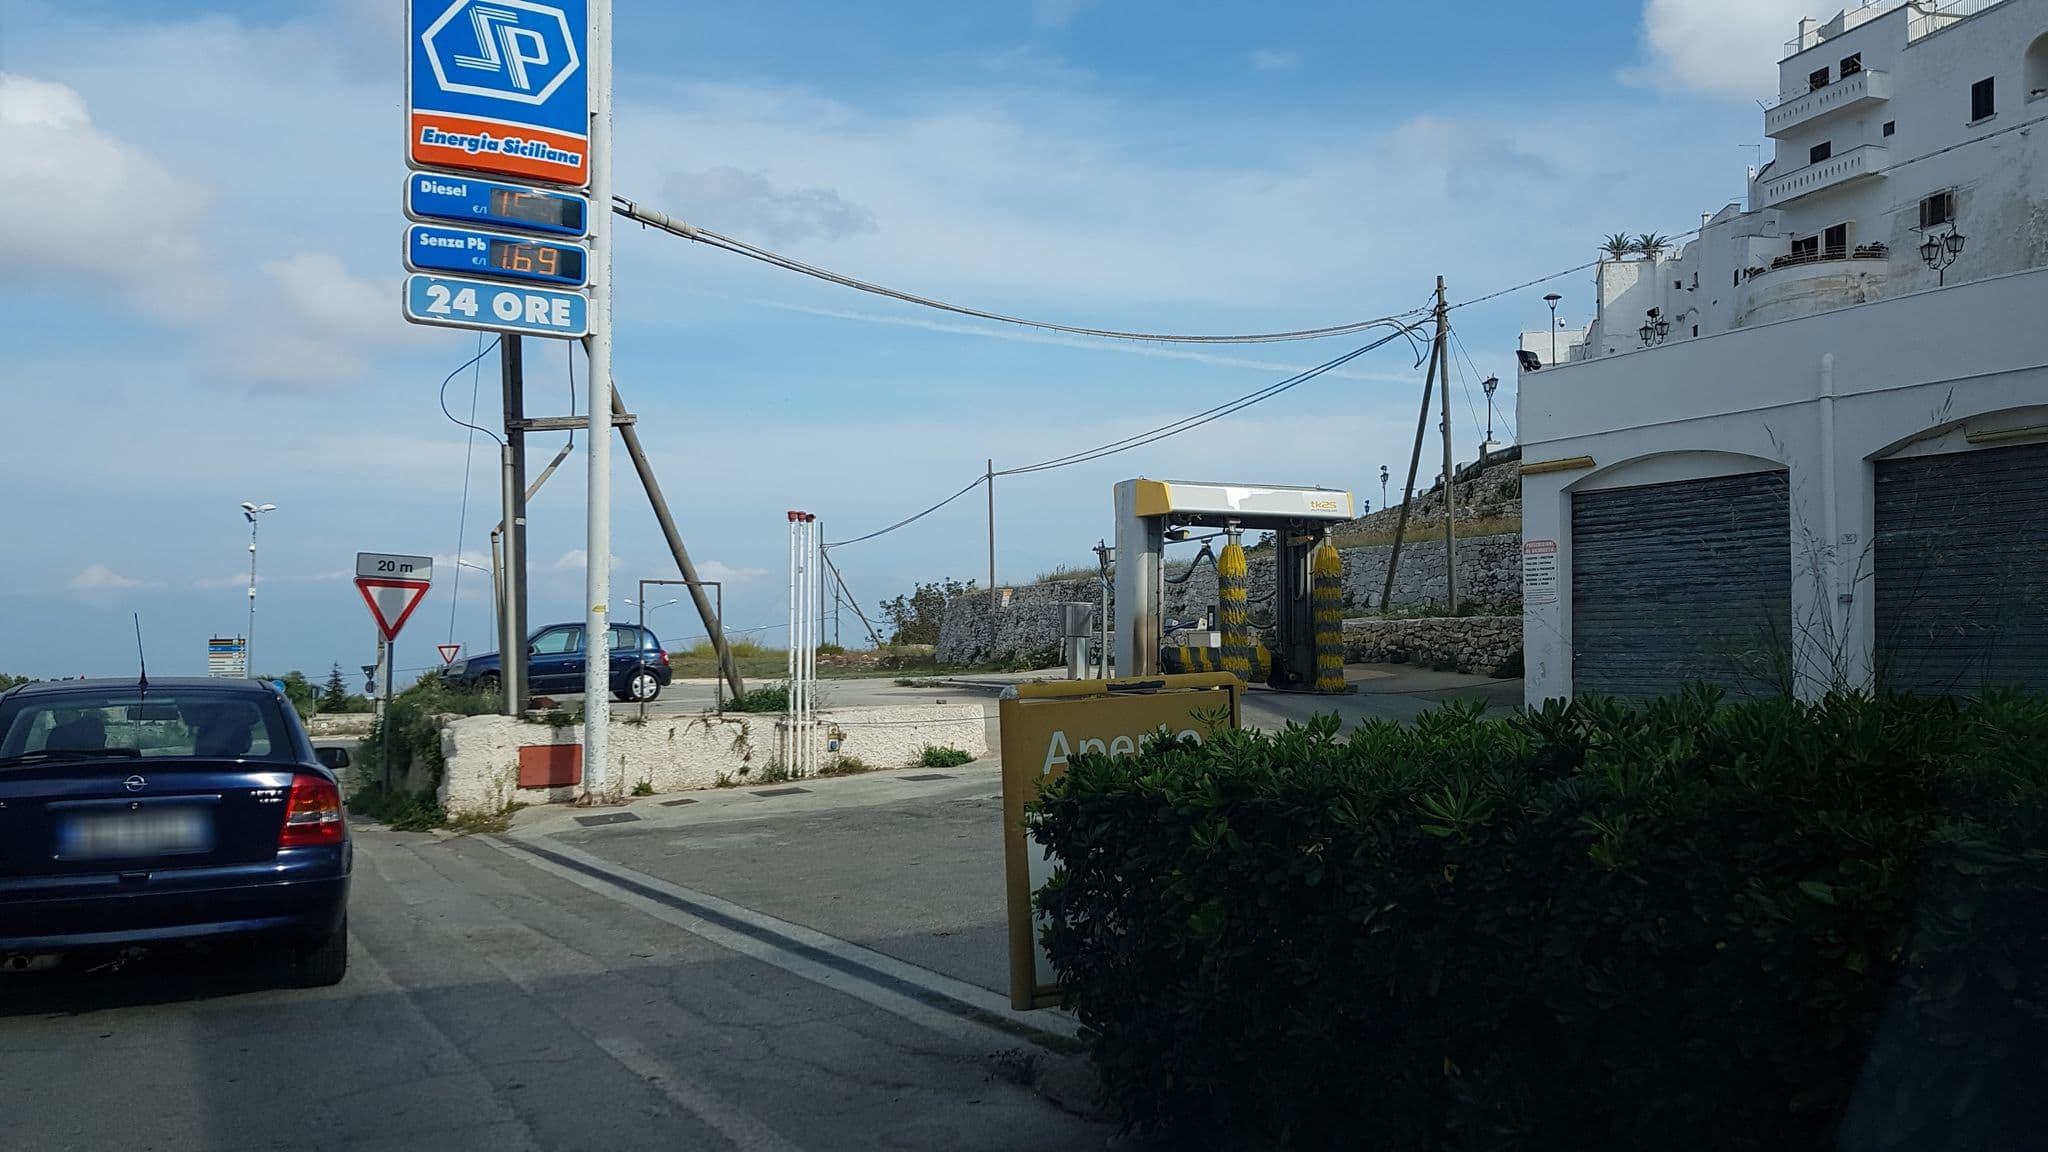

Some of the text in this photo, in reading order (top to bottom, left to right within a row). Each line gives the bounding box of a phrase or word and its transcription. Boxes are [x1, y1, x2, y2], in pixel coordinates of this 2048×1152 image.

[422, 128, 580, 165] Energia Siciliana
[420, 180, 467, 197] Diesel
[420, 232, 487, 251] Senza Pb
[426, 284, 571, 327] 24 ORE
[378, 560, 413, 573] 20 m
[1043, 722, 1202, 775] Aper
